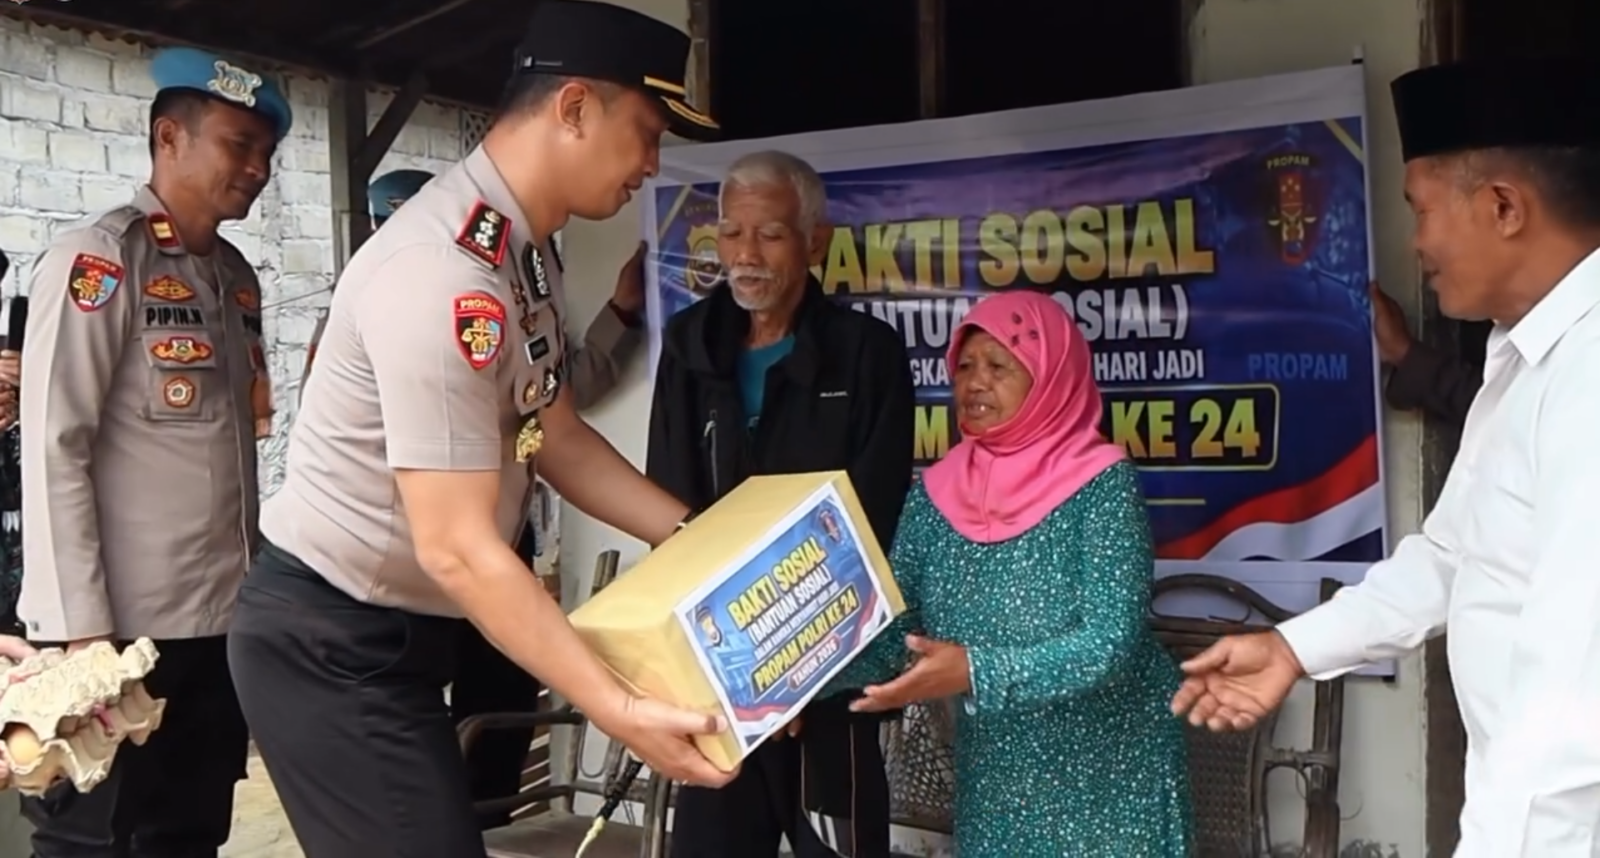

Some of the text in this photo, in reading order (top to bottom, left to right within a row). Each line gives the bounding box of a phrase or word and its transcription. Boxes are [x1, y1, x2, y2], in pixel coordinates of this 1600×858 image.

[1267, 155, 1310, 169] PROPAM
[809, 198, 1214, 295] AKTI SOSIAL
[460, 299, 500, 313] PROPAM
[1094, 351, 1147, 381] HARI
[1152, 349, 1204, 380] JADI
[1249, 353, 1347, 380] PROPAM
[1111, 398, 1260, 459] KE 24
[728, 537, 826, 630] BAKTI SOSIAL
[747, 565, 833, 646] (BANTUAN SOSIAL)
[753, 589, 858, 691] PROPAM POLRI KE 24
[791, 655, 819, 686] TAHUN
